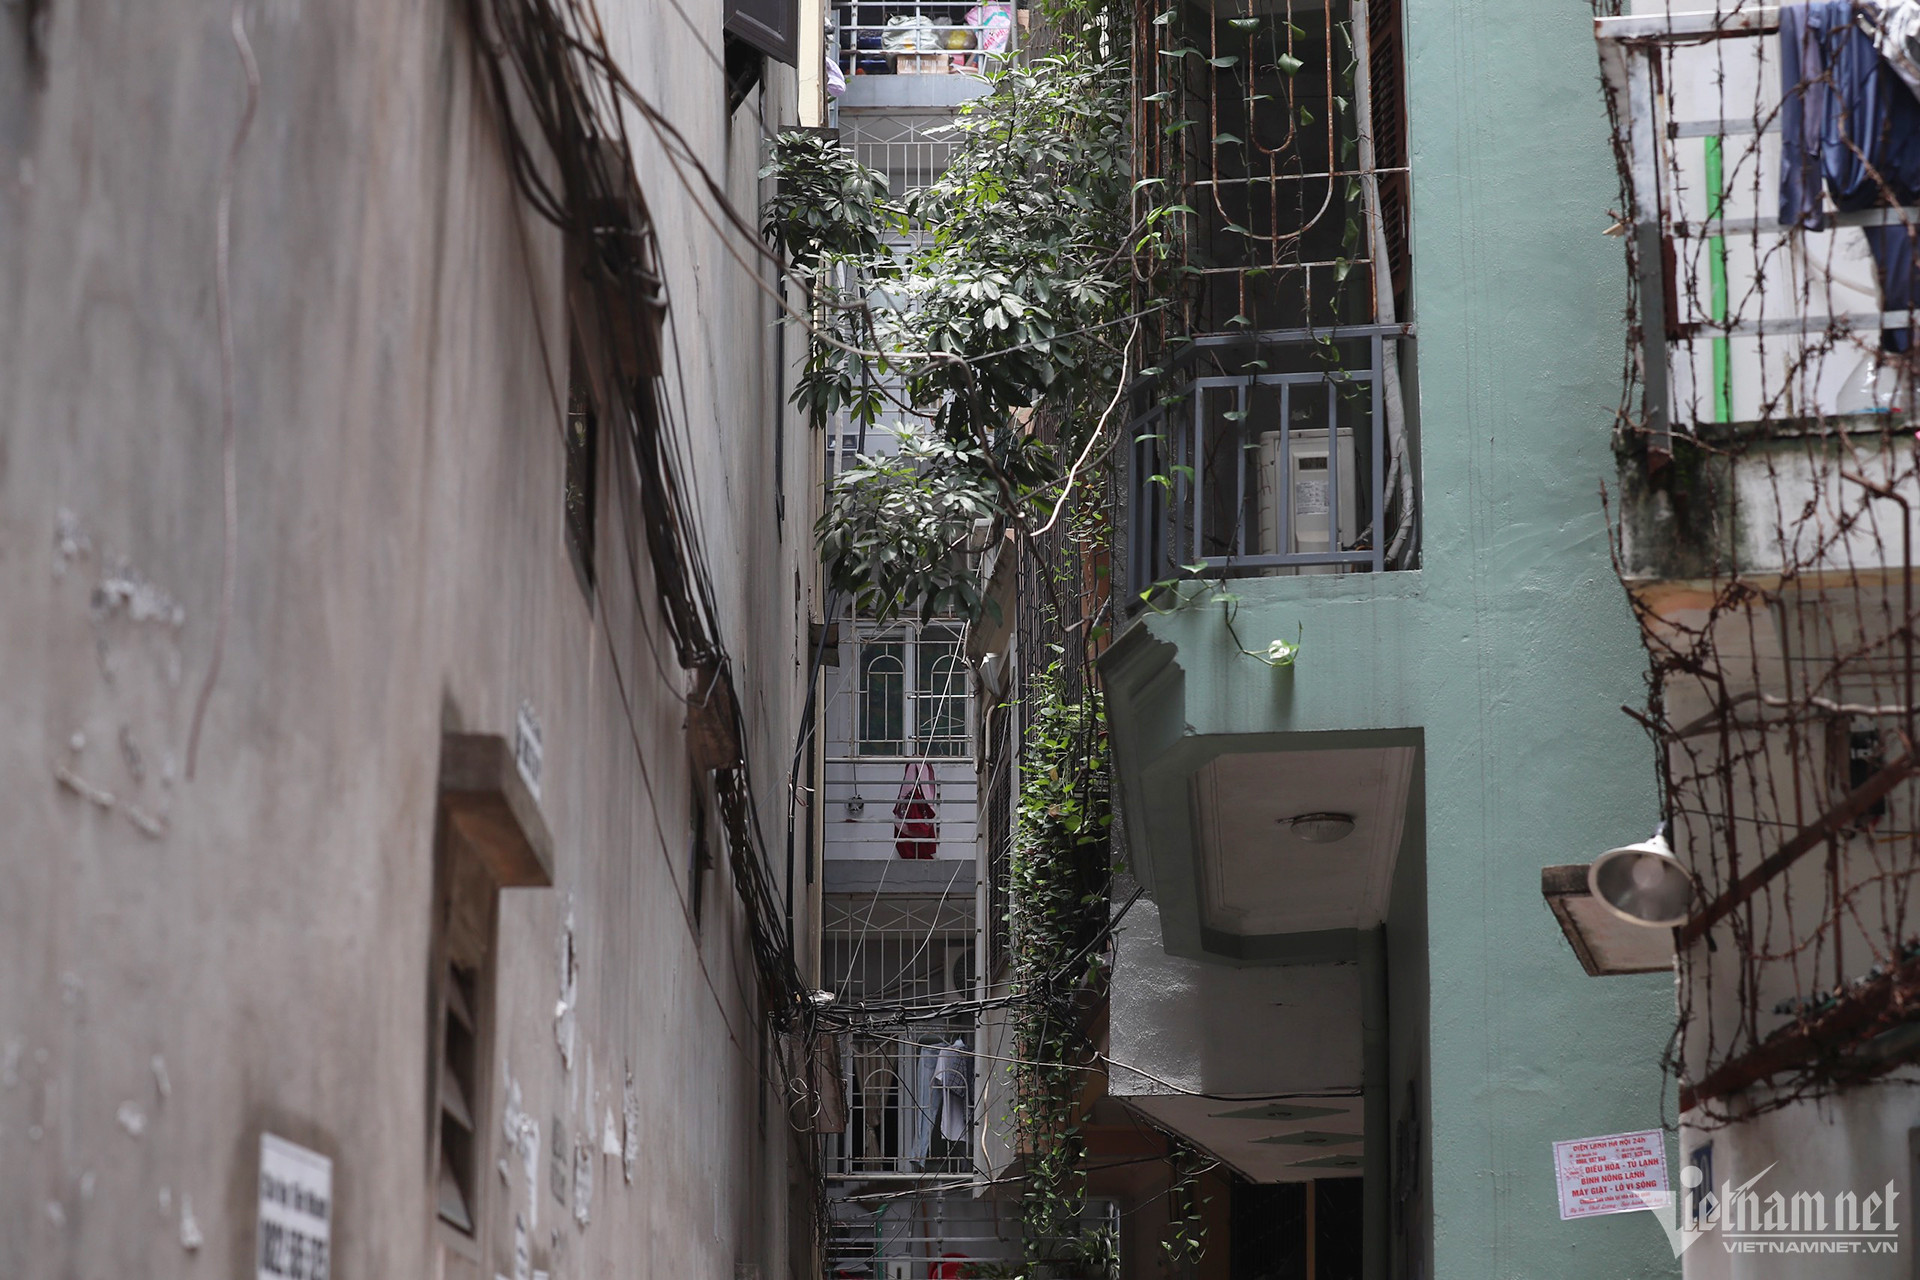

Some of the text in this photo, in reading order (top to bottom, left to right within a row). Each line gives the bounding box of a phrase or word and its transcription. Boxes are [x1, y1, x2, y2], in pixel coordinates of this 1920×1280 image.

[1639, 1158, 1659, 1168] LẠNH
[1581, 1170, 1645, 1185] BÌNH NÓNG LẠNH
[1626, 1182, 1634, 1190] VI
[1636, 1179, 1657, 1189] SÓNG
